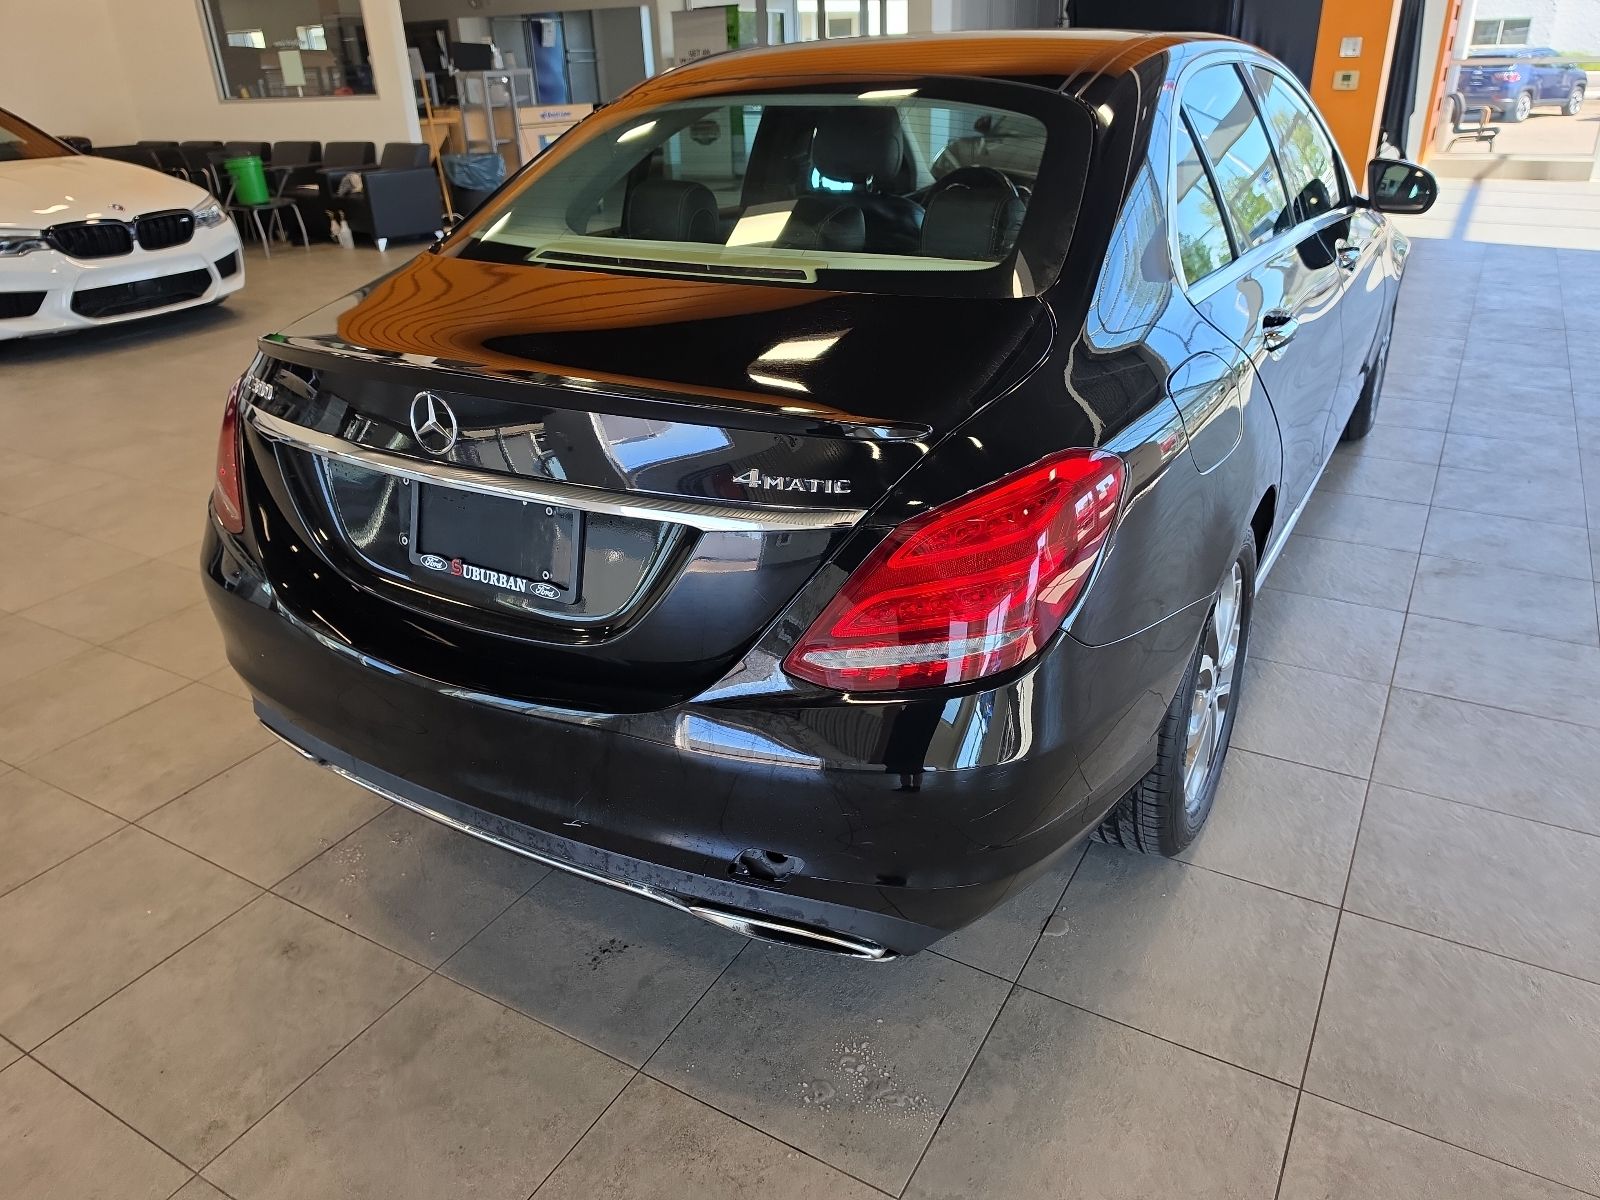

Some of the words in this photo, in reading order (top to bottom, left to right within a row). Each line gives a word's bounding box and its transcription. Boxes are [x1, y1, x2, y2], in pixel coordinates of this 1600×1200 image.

[732, 468, 851, 493] 4MATIC
[424, 556, 443, 569] Ford
[451, 558, 526, 592] SUBURBAN
[535, 583, 555, 598] Ford
